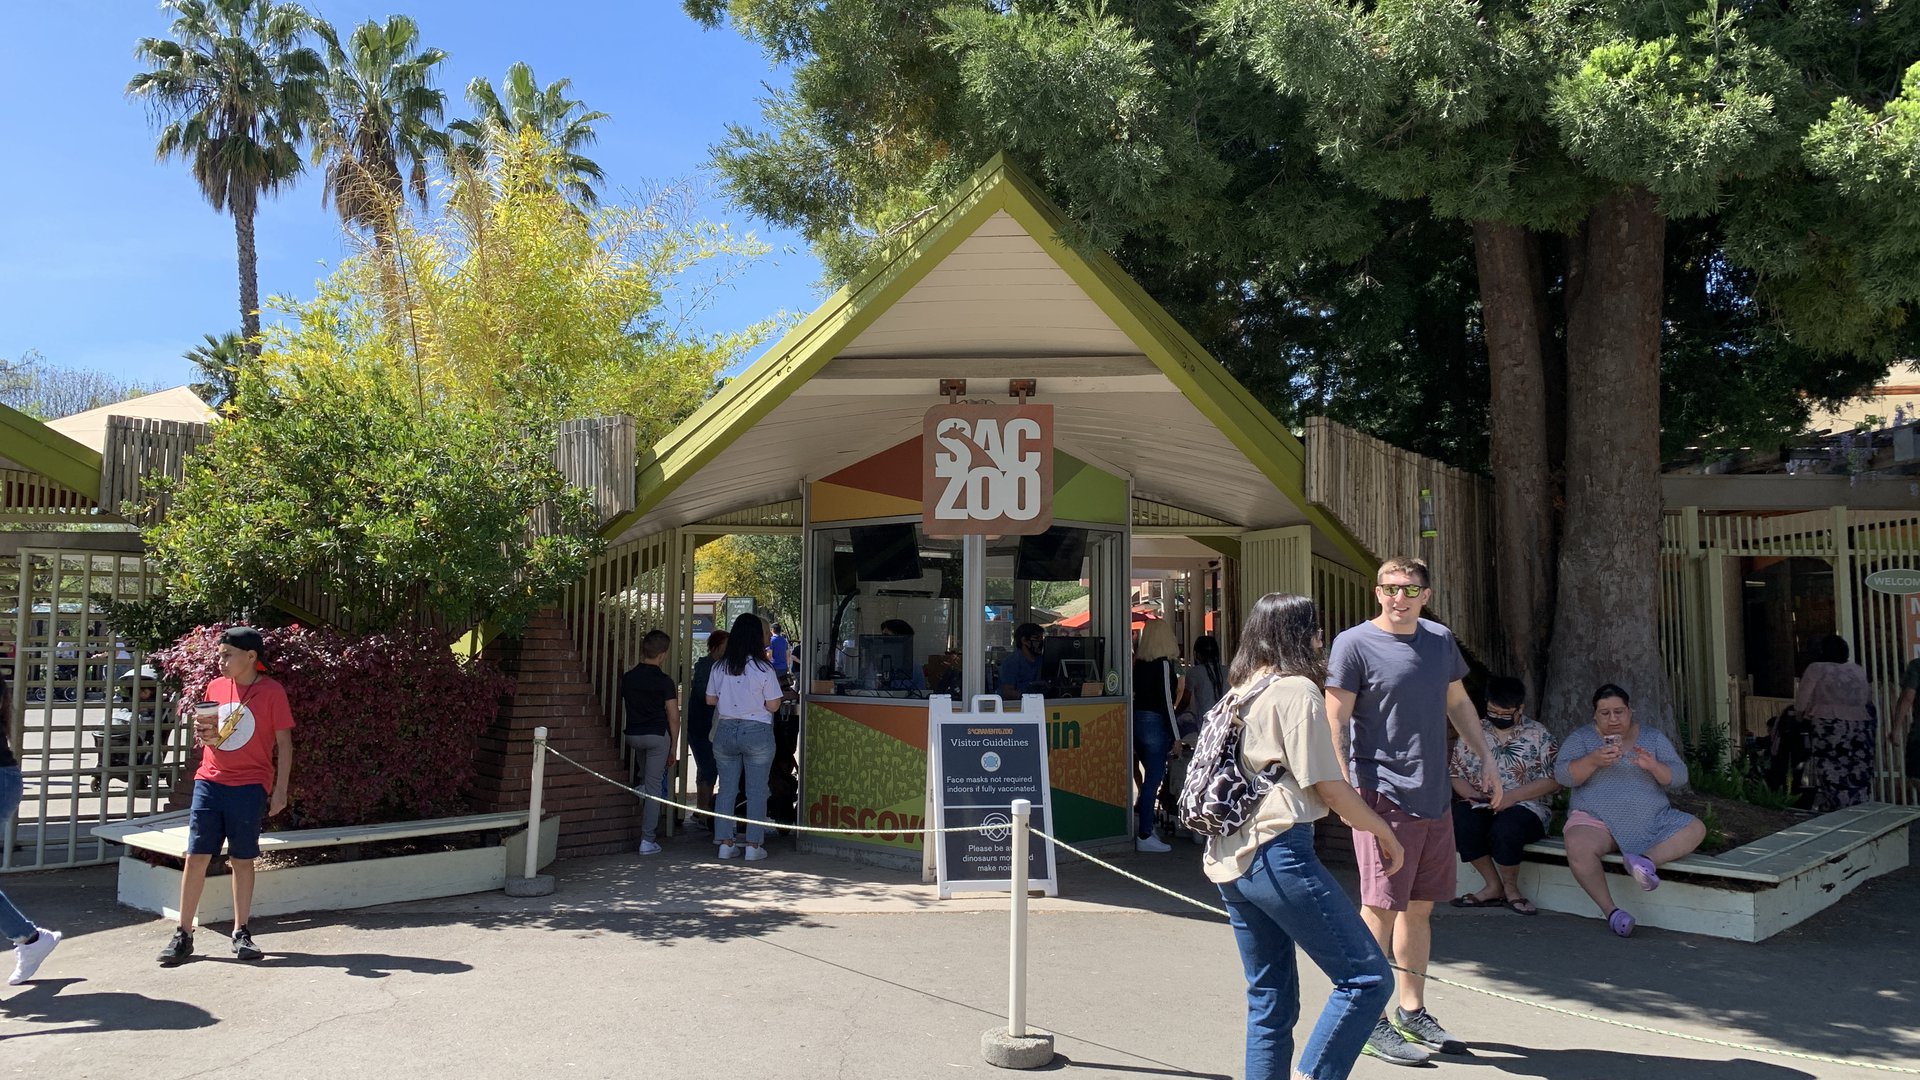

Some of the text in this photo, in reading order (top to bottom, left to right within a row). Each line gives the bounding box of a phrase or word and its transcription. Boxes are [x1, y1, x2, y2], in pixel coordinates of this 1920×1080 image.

[935, 417, 1041, 471] SAC
[934, 465, 1041, 521] ZOO
[1873, 577, 1920, 587] WELCOM
[1046, 712, 1080, 756] in
[950, 738, 1029, 747] Visitor Guidelines
[946, 776, 965, 784] Face
[1003, 775, 1033, 785] required
[981, 785, 996, 795] fully
[810, 795, 925, 843] discov
[968, 844, 993, 852] Please
[994, 844, 1004, 852] be
[962, 853, 998, 862] dinosaurs
[977, 864, 997, 872] make
